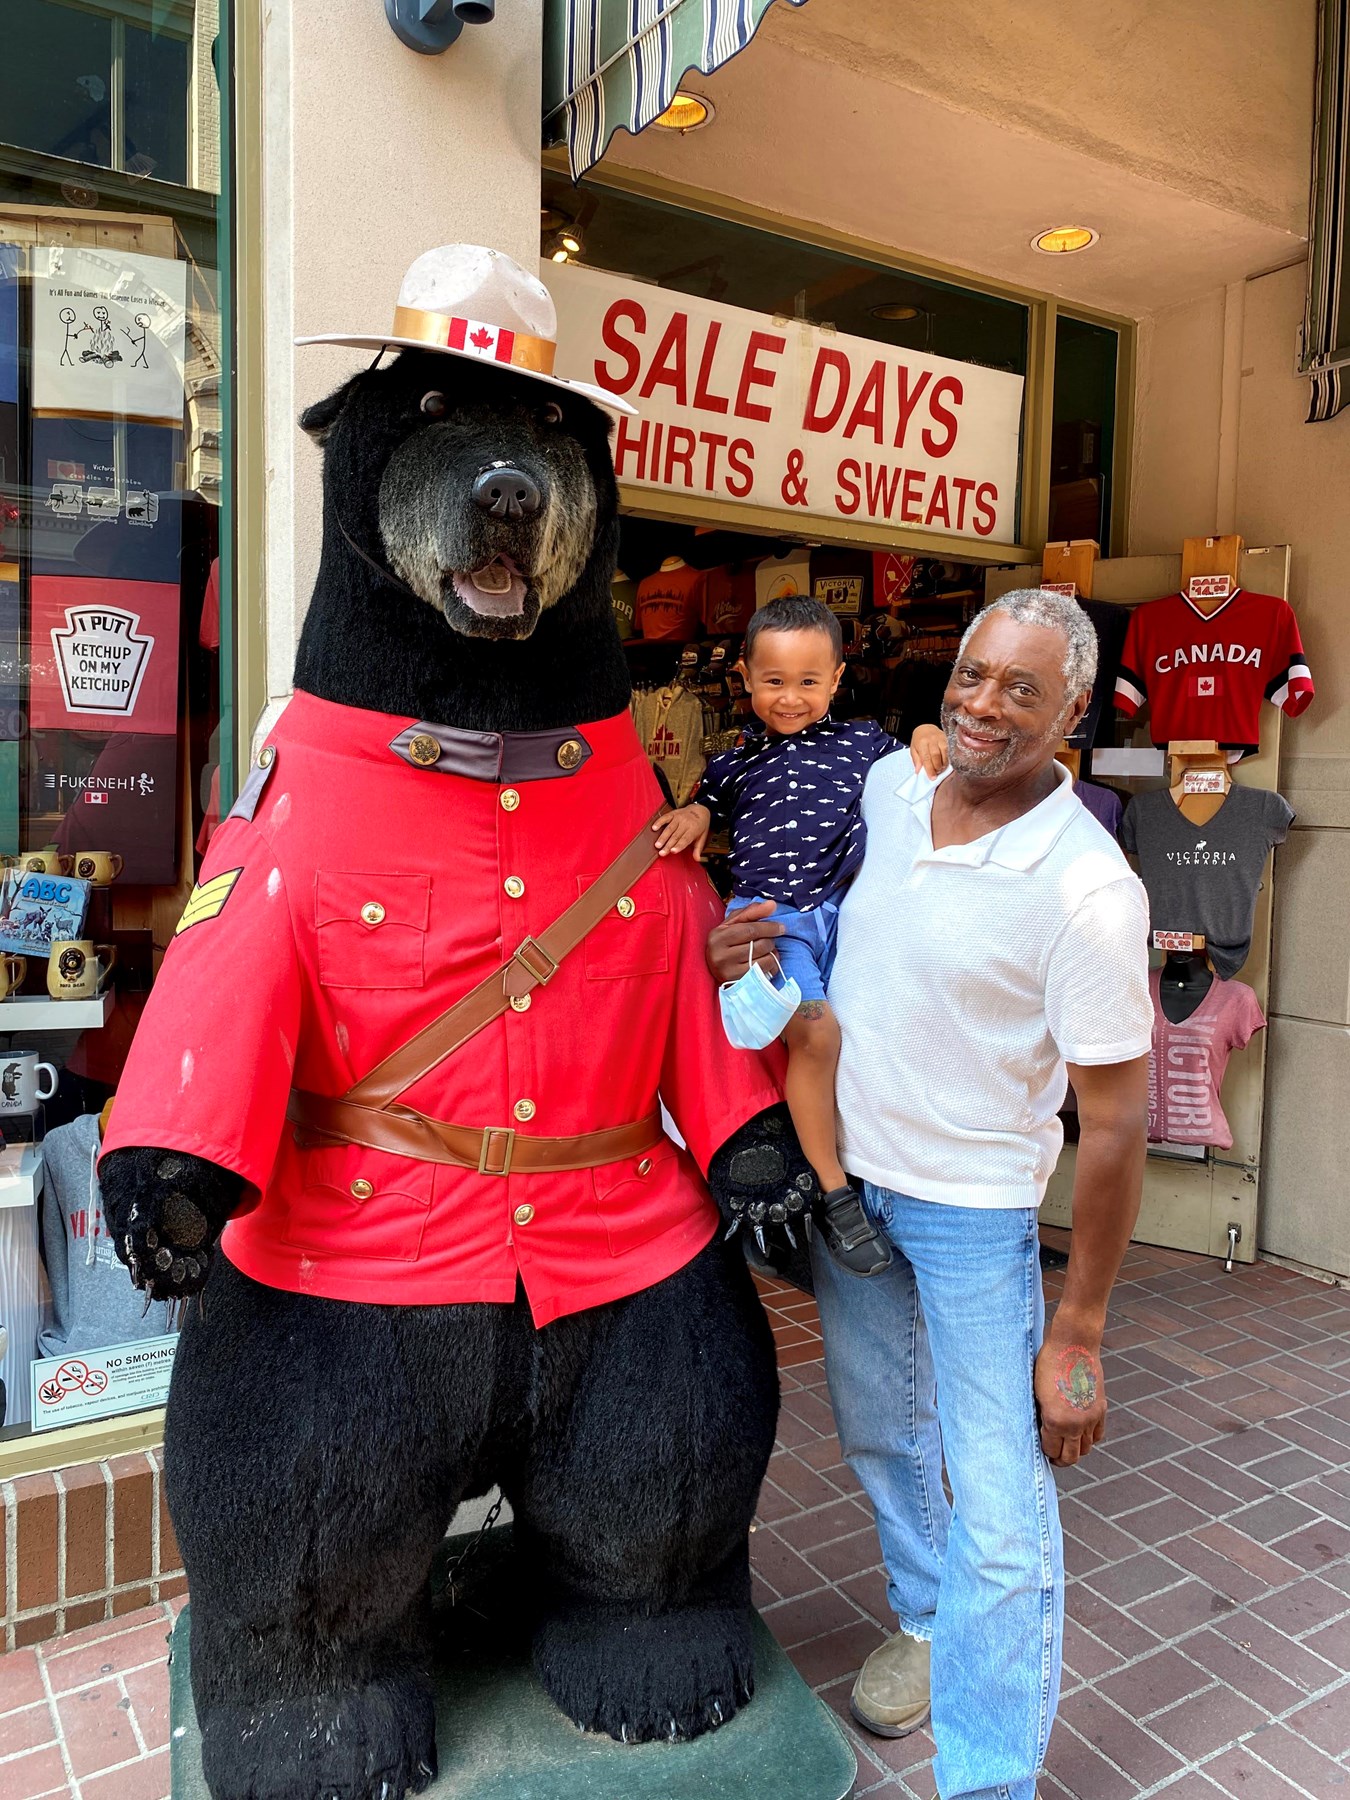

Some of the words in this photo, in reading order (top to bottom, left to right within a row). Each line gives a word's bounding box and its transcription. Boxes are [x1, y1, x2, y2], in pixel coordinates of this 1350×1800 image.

[64, 289, 73, 297] Fun
[83, 290, 98, 298] Games
[594, 299, 787, 422] SALE
[802, 347, 963, 458] DAYS
[92, 464, 116, 472] Victoria
[615, 416, 754, 497] HIRTS
[781, 449, 808, 506] &
[835, 458, 998, 535] SWEATS
[820, 580, 856, 591] VICTORIA
[611, 599, 633, 620] ADA
[78, 618, 87, 632] I
[91, 616, 126, 633] PUT
[72, 643, 131, 659] KETCHUP
[1155, 643, 1261, 673] CANADA
[79, 660, 97, 673] ON
[100, 660, 121, 675] MY
[71, 676, 130, 693] KETCHUP
[60, 774, 135, 791] FUKENEH!
[1166, 851, 1236, 861] VICTORIA
[22, 878, 72, 904] ABC
[1155, 931, 1192, 939] SALE
[1167, 1015, 1218, 1141] VICTORI
[106, 1358, 122, 1369] NO
[125, 1347, 176, 1365] SMOKING
